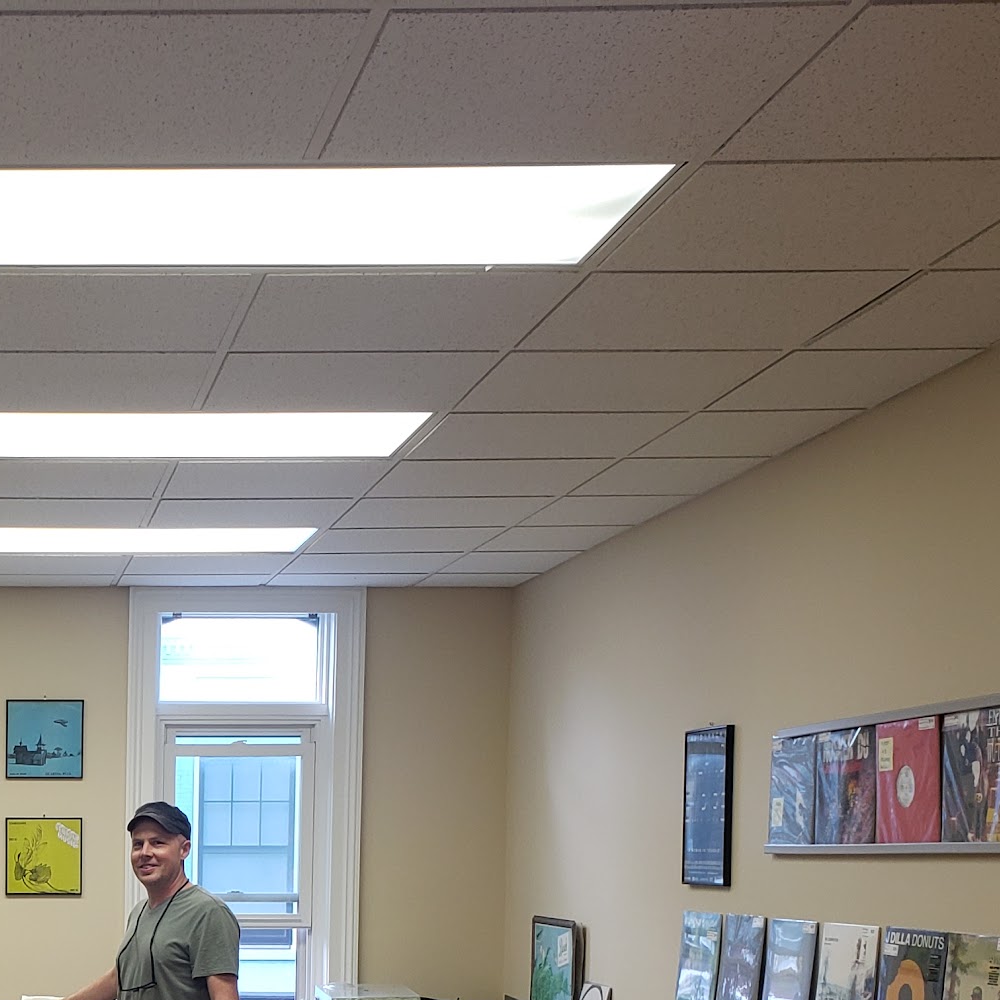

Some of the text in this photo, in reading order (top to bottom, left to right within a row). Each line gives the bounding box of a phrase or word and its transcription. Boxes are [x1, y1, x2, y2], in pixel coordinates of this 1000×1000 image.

[885, 931, 890, 943] J
[890, 931, 910, 946] DILLA
[911, 934, 945, 950] DONUTS
